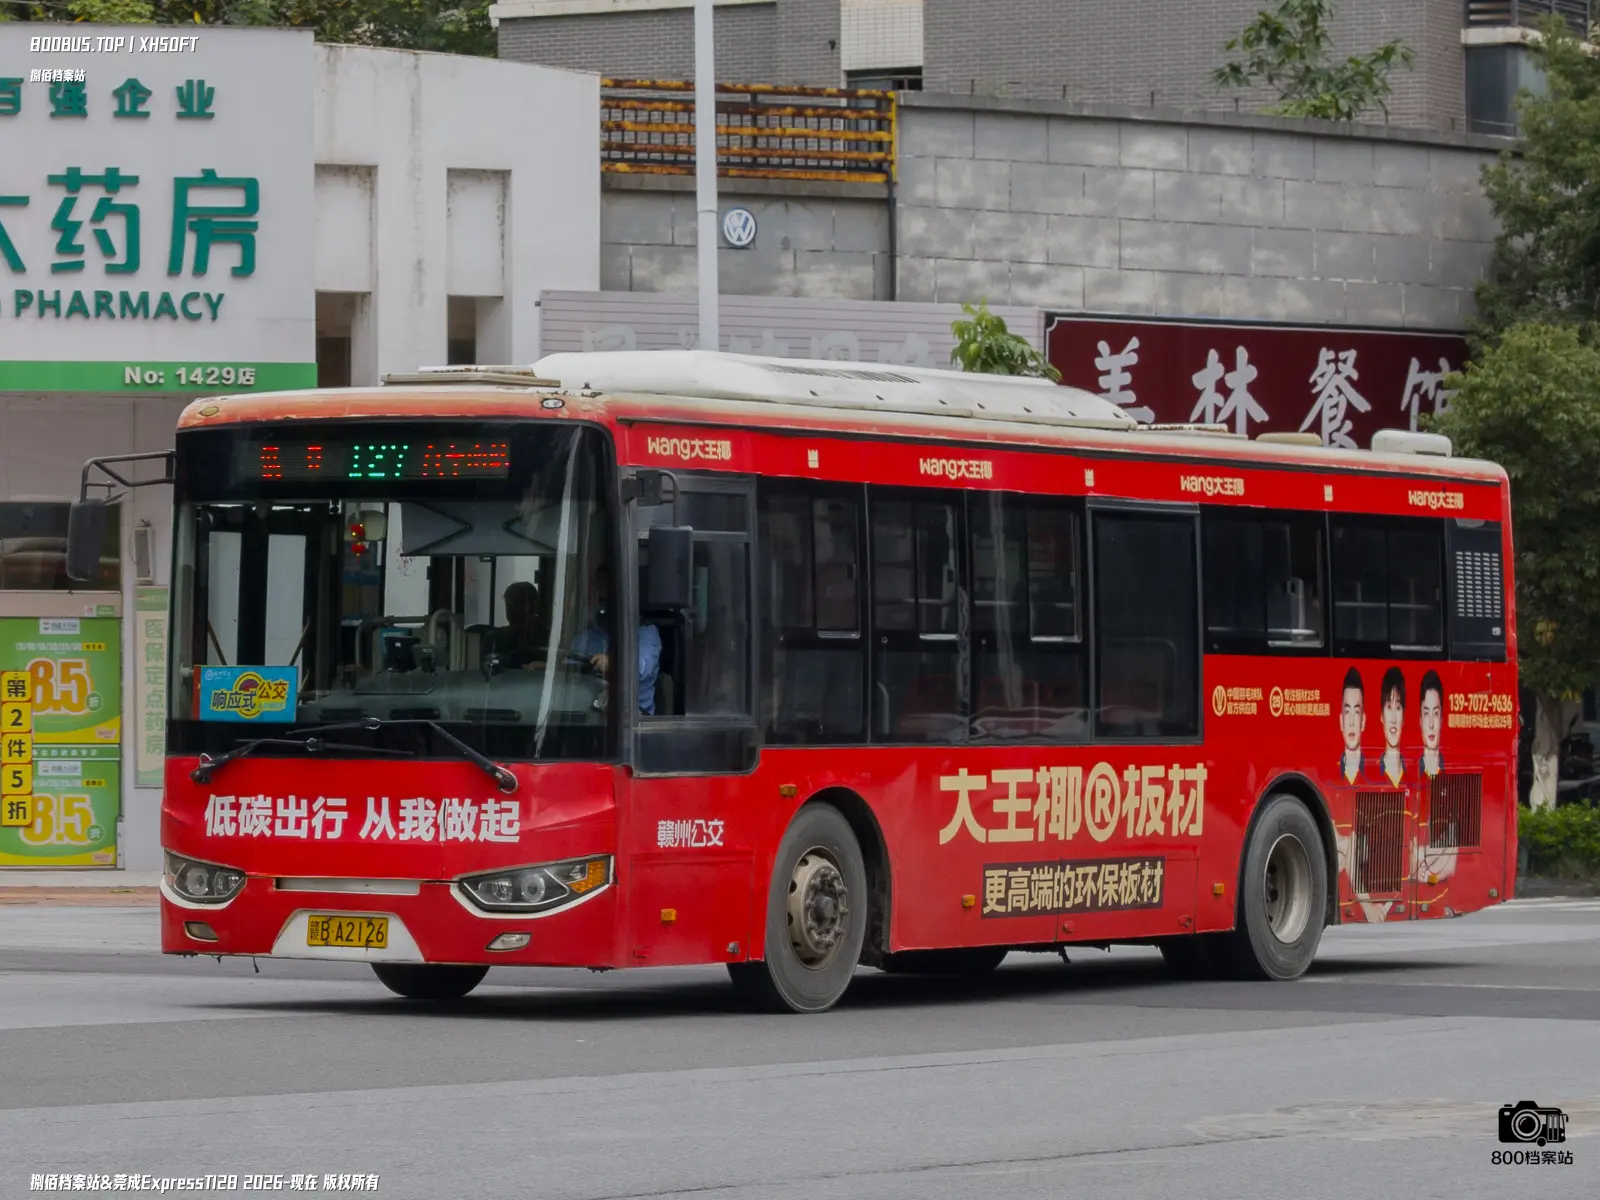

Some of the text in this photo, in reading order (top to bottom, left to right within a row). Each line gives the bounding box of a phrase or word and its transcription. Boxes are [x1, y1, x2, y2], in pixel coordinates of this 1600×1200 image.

[15, 289, 225, 321] PHARMACY
[176, 367, 256, 385] 1429店
[349, 444, 408, 477] 127
[212, 690, 257, 709] 响应式
[258, 680, 288, 700] 公交
[1448, 693, 1513, 712] 139-7072-9636
[205, 794, 521, 844] 低碳出行 从我做起
[657, 819, 724, 848] 赣州公交
[982, 861, 1164, 914] 更高端的环保板材
